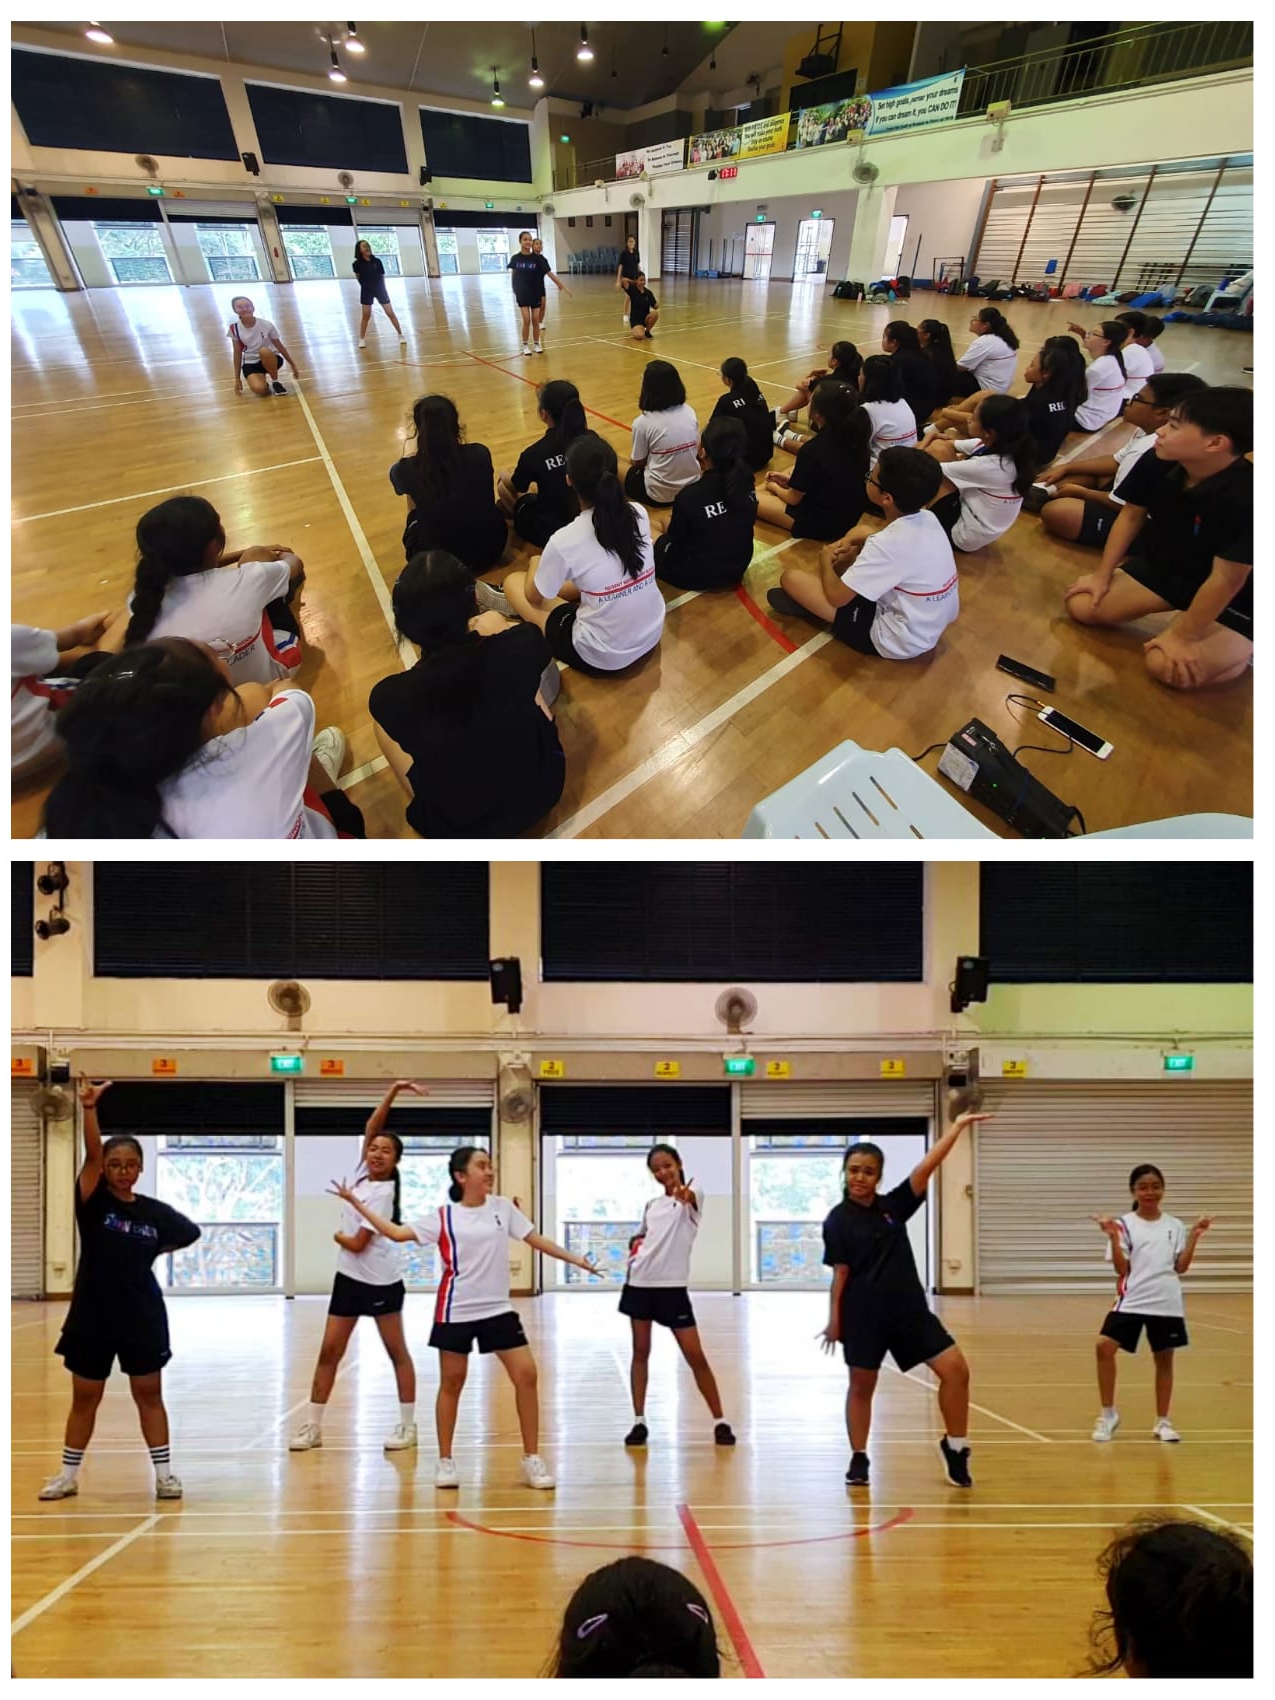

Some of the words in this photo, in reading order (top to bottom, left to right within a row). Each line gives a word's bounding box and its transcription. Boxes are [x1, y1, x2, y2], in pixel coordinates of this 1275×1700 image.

[885, 100, 895, 109] high
[926, 91, 938, 101] your
[938, 87, 958, 97] dreams
[879, 116, 888, 124] you
[897, 110, 911, 118] dream
[917, 108, 927, 117] you
[927, 103, 940, 113] CAN
[940, 101, 949, 110] DO
